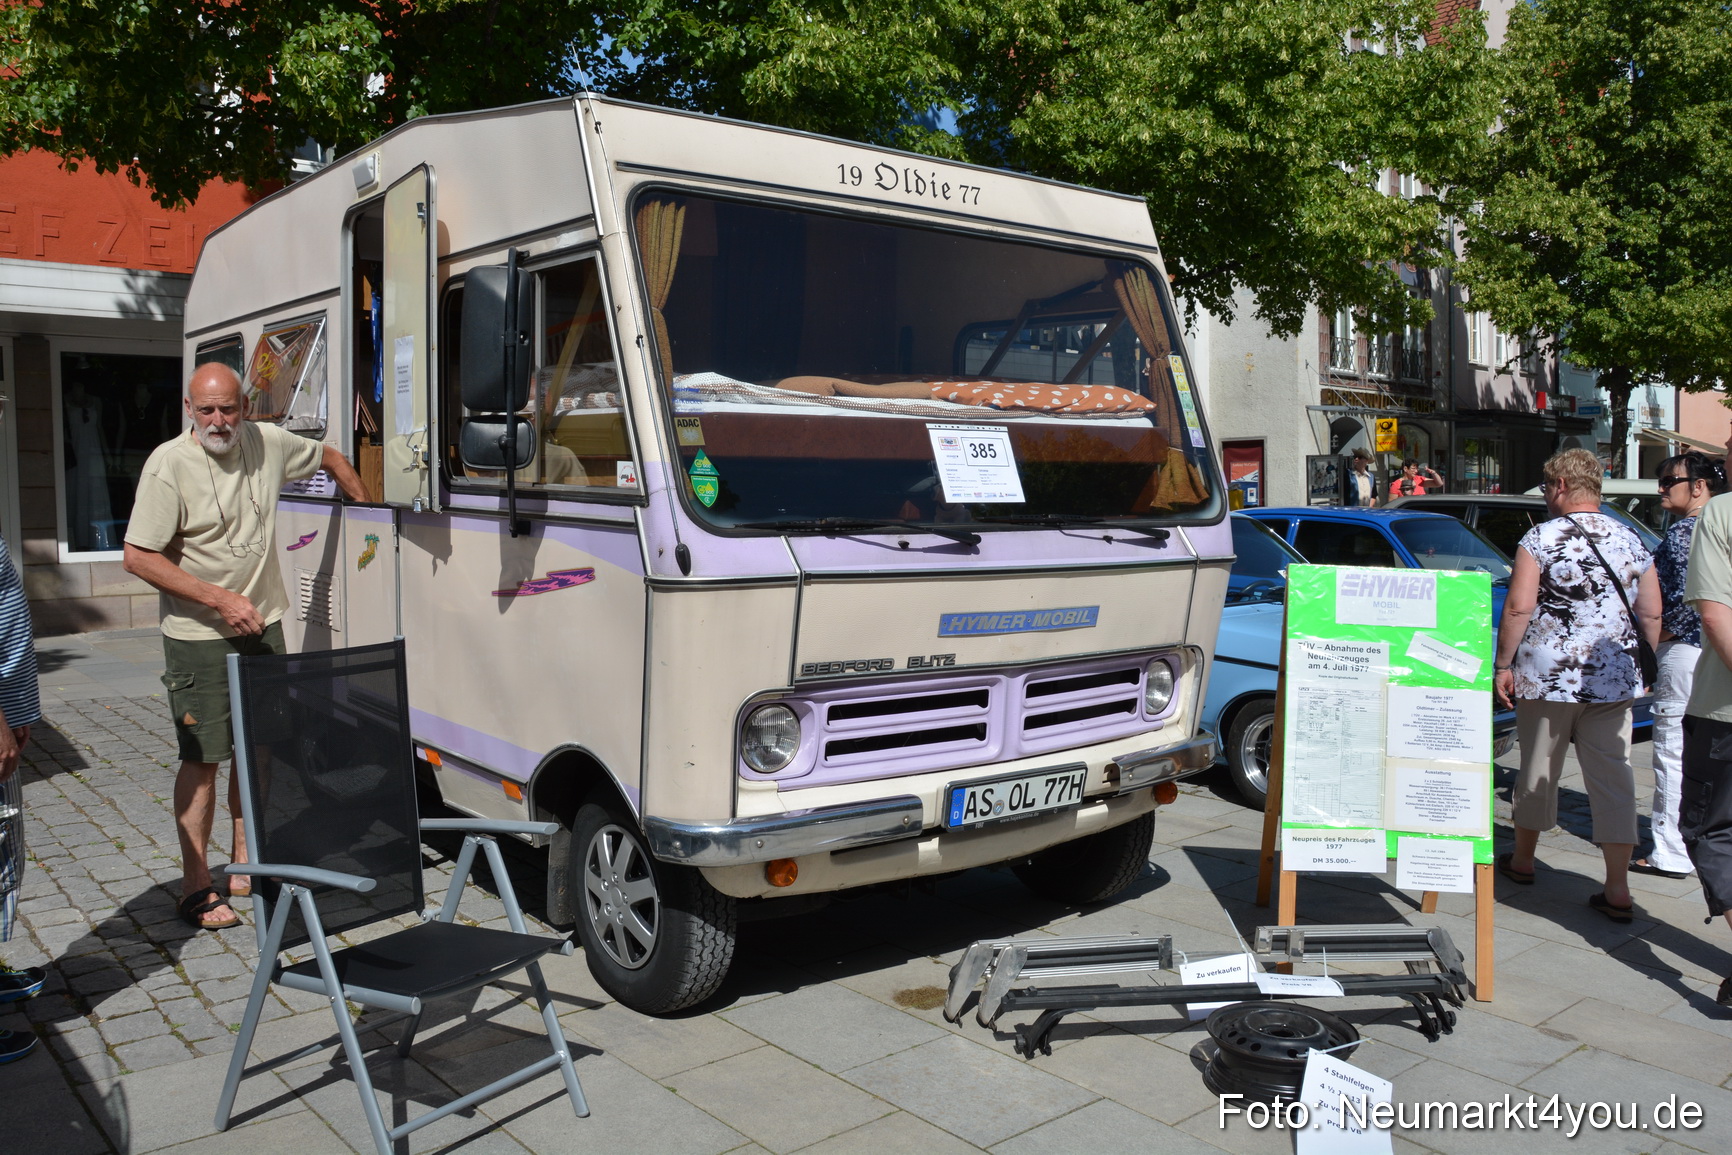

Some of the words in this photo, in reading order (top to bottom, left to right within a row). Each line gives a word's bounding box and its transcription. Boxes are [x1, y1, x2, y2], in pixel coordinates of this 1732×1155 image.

[838, 164, 862, 186] 19
[874, 162, 951, 200] Oldie
[959, 184, 981, 205] 77
[98, 214, 215, 269] ZEI
[677, 419, 699, 428] ADAC
[970, 443, 997, 458] 385
[948, 614, 1026, 631] HYMER
[1032, 610, 1091, 626] MOBIL
[1324, 644, 1364, 653] Abnahme
[801, 658, 894, 676] BEDFORD
[907, 653, 956, 669] BLITZ
[964, 788, 994, 820] AS
[1009, 782, 1036, 811] OL
[1044, 773, 1084, 805] 77H
[954, 811, 959, 819] D
[1207, 966, 1241, 977] verkaufen
[1331, 1070, 1374, 1093] Stahlfelgen
[1319, 1100, 1328, 1108] Zu
[1327, 1120, 1348, 1130] Pres
